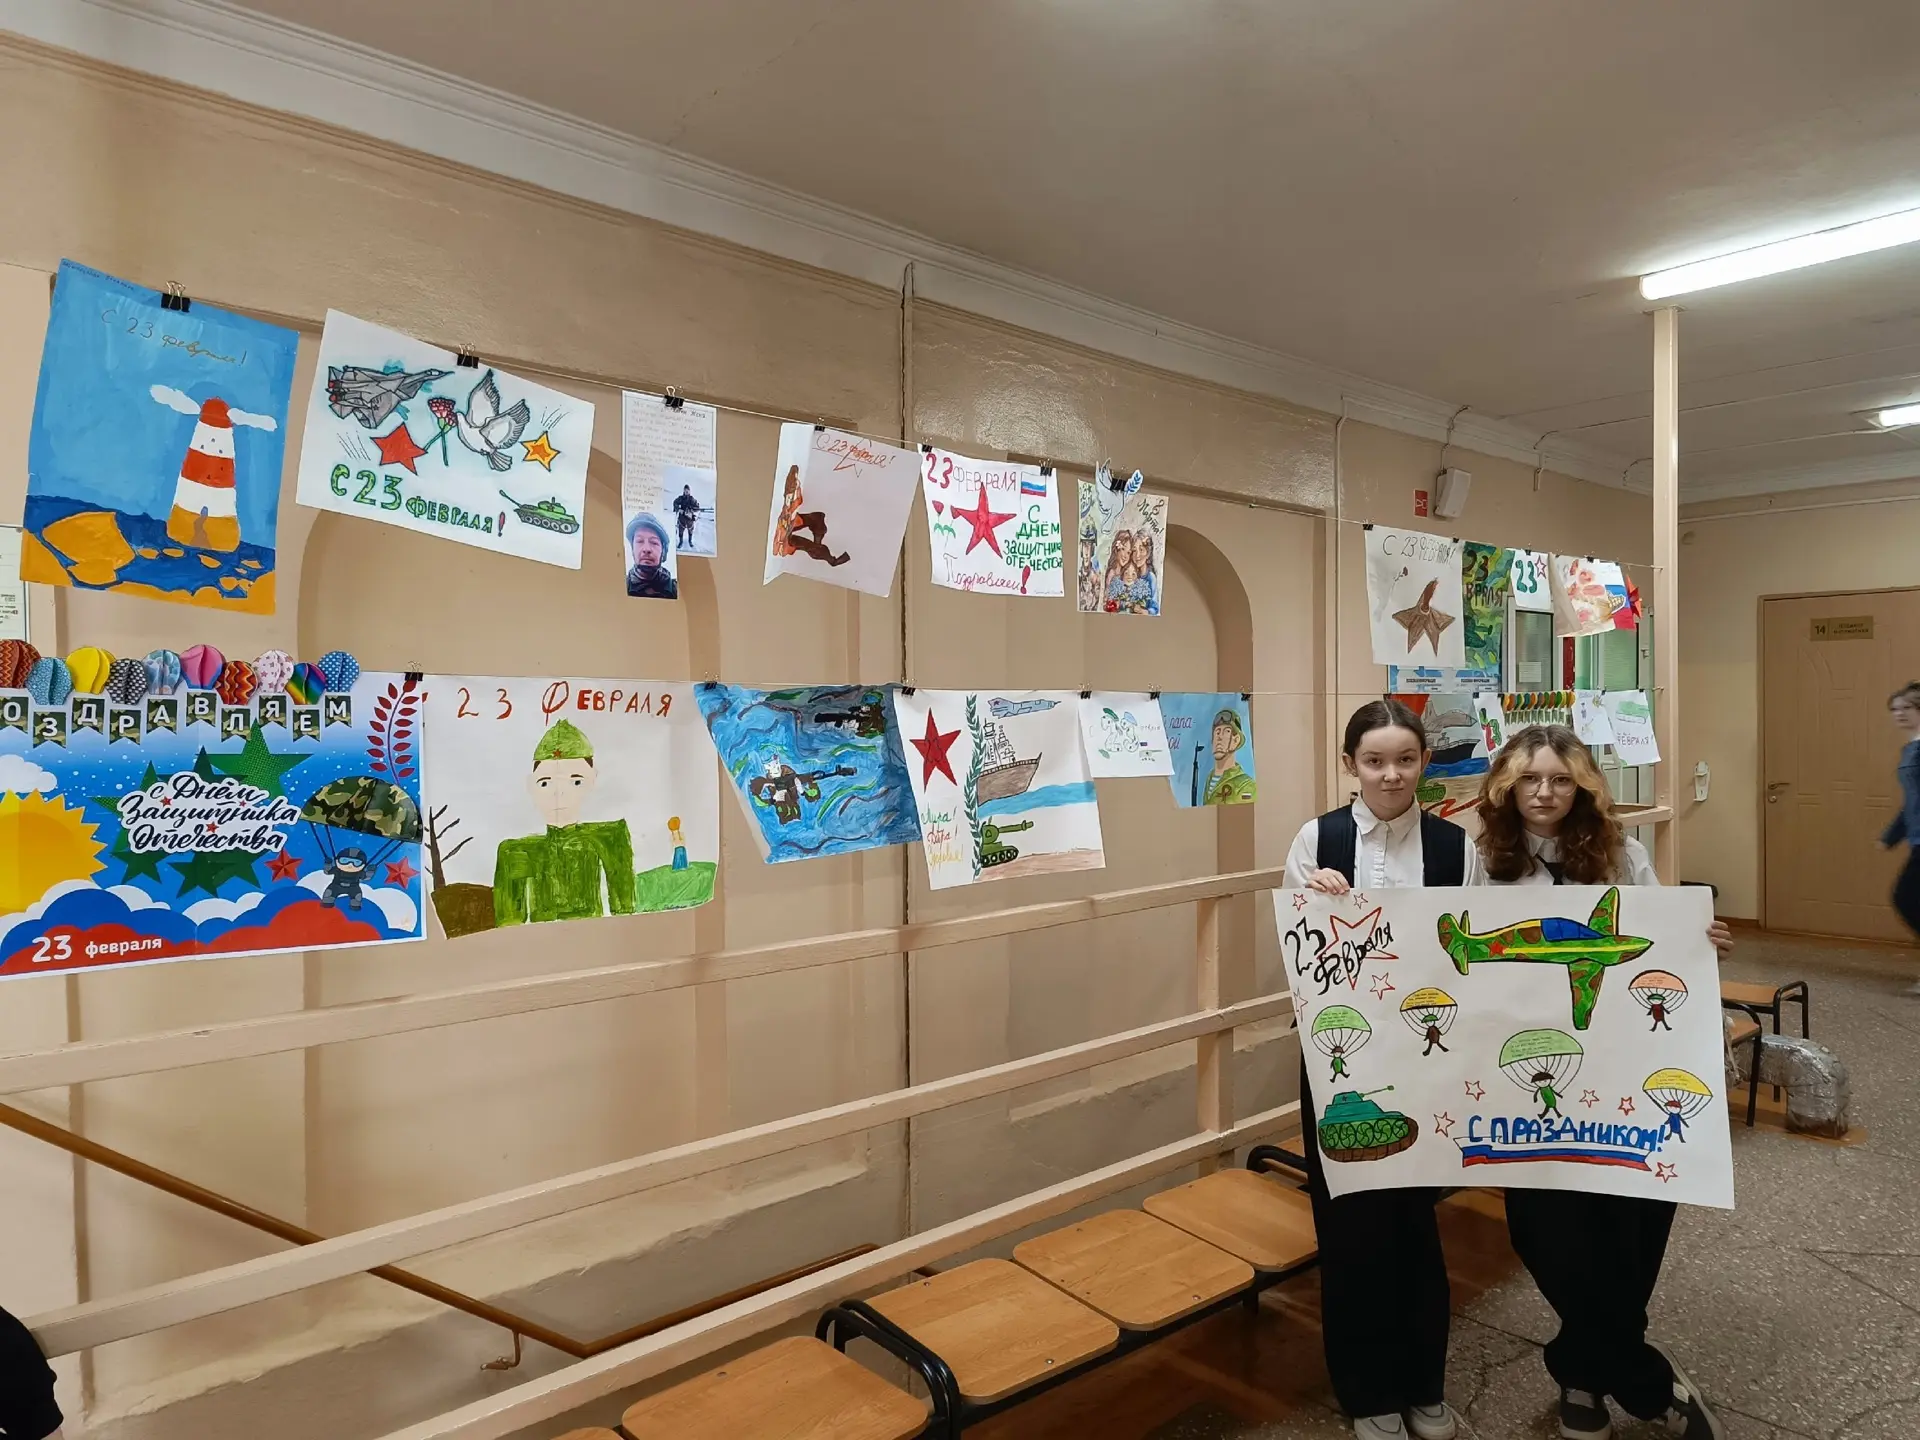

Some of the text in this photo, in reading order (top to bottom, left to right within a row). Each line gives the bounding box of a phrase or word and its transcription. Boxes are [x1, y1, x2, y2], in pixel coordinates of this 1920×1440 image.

[125, 317, 153, 338] 23
[828, 440, 848, 452] 23
[926, 453, 953, 489] 23
[353, 470, 402, 511] 23
[405, 495, 506, 537] ФЕВРАЛЯ!
[1401, 536, 1418, 557] 23
[1515, 560, 1538, 593] 23
[1466, 583, 1503, 607] ВРАЛЯ
[1815, 625, 1826, 634] 14
[3, 696, 347, 737] ОЗДРАВЛЯЕМ
[172, 774, 266, 801] Днём
[121, 795, 298, 828] Защитника
[132, 823, 284, 850] Отечества
[32, 935, 162, 963] 23 февраля
[1284, 915, 1326, 976] 23
[1490, 1116, 1665, 1152] ПРАЗДНИКОМ!
